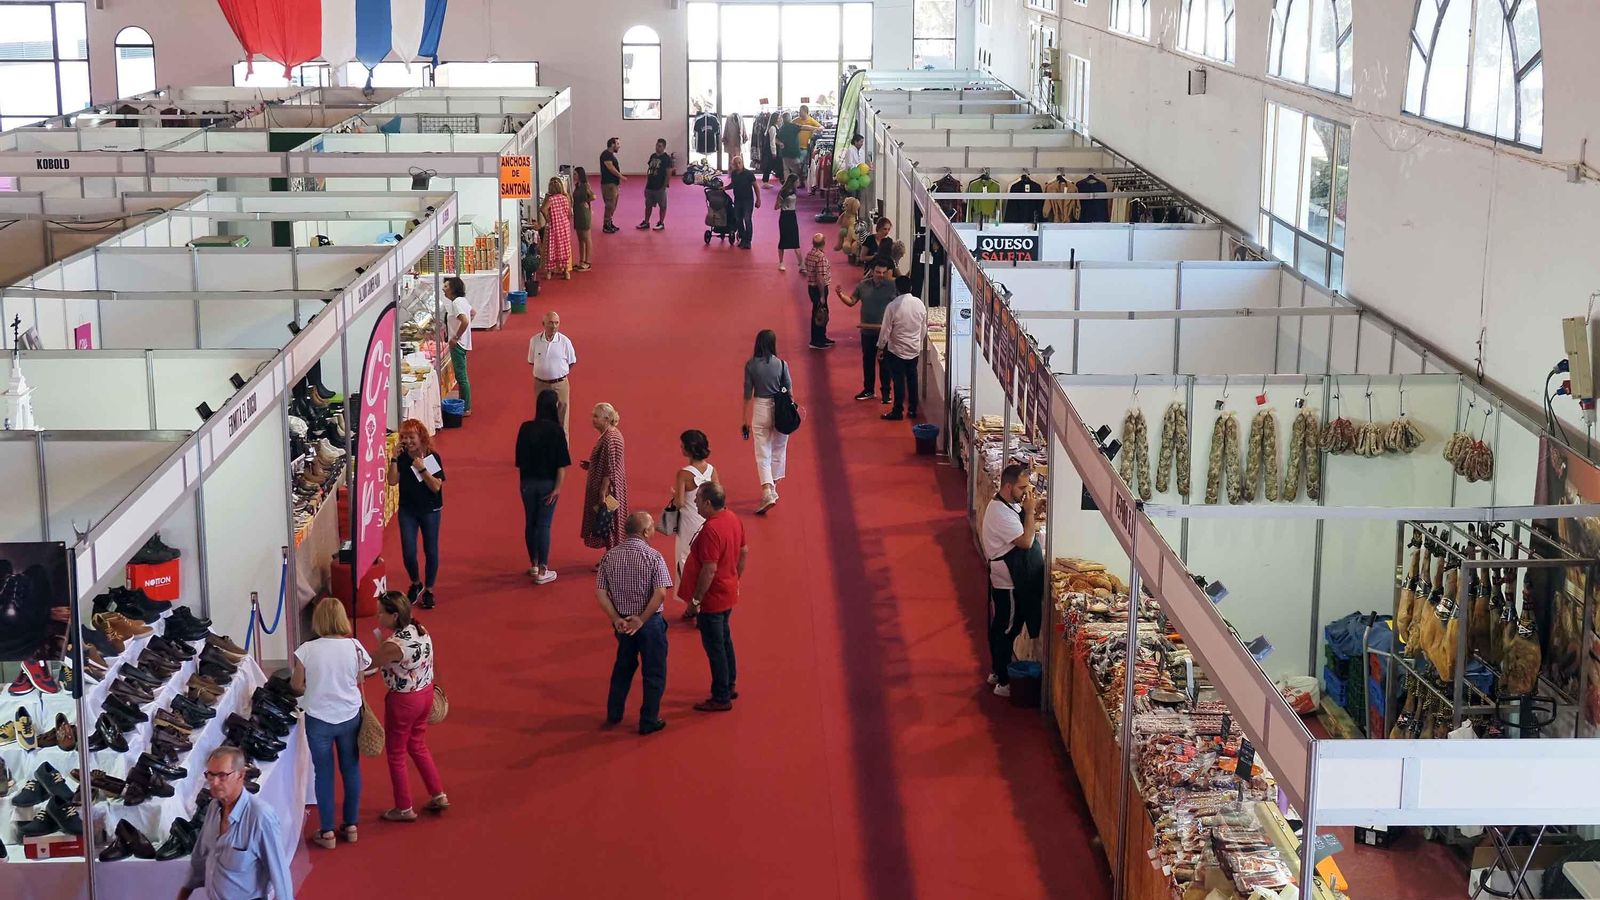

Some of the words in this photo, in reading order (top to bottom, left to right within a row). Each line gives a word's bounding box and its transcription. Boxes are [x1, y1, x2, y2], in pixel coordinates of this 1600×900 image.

[36, 158, 70, 170] KOBOLD
[501, 156, 531, 167] ANCHOAS
[511, 169, 520, 177] DE
[501, 180, 531, 195] SANTOÑA
[982, 238, 1034, 252] QUESO
[981, 251, 1033, 262] SALETA
[144, 576, 171, 587] NOTTON
